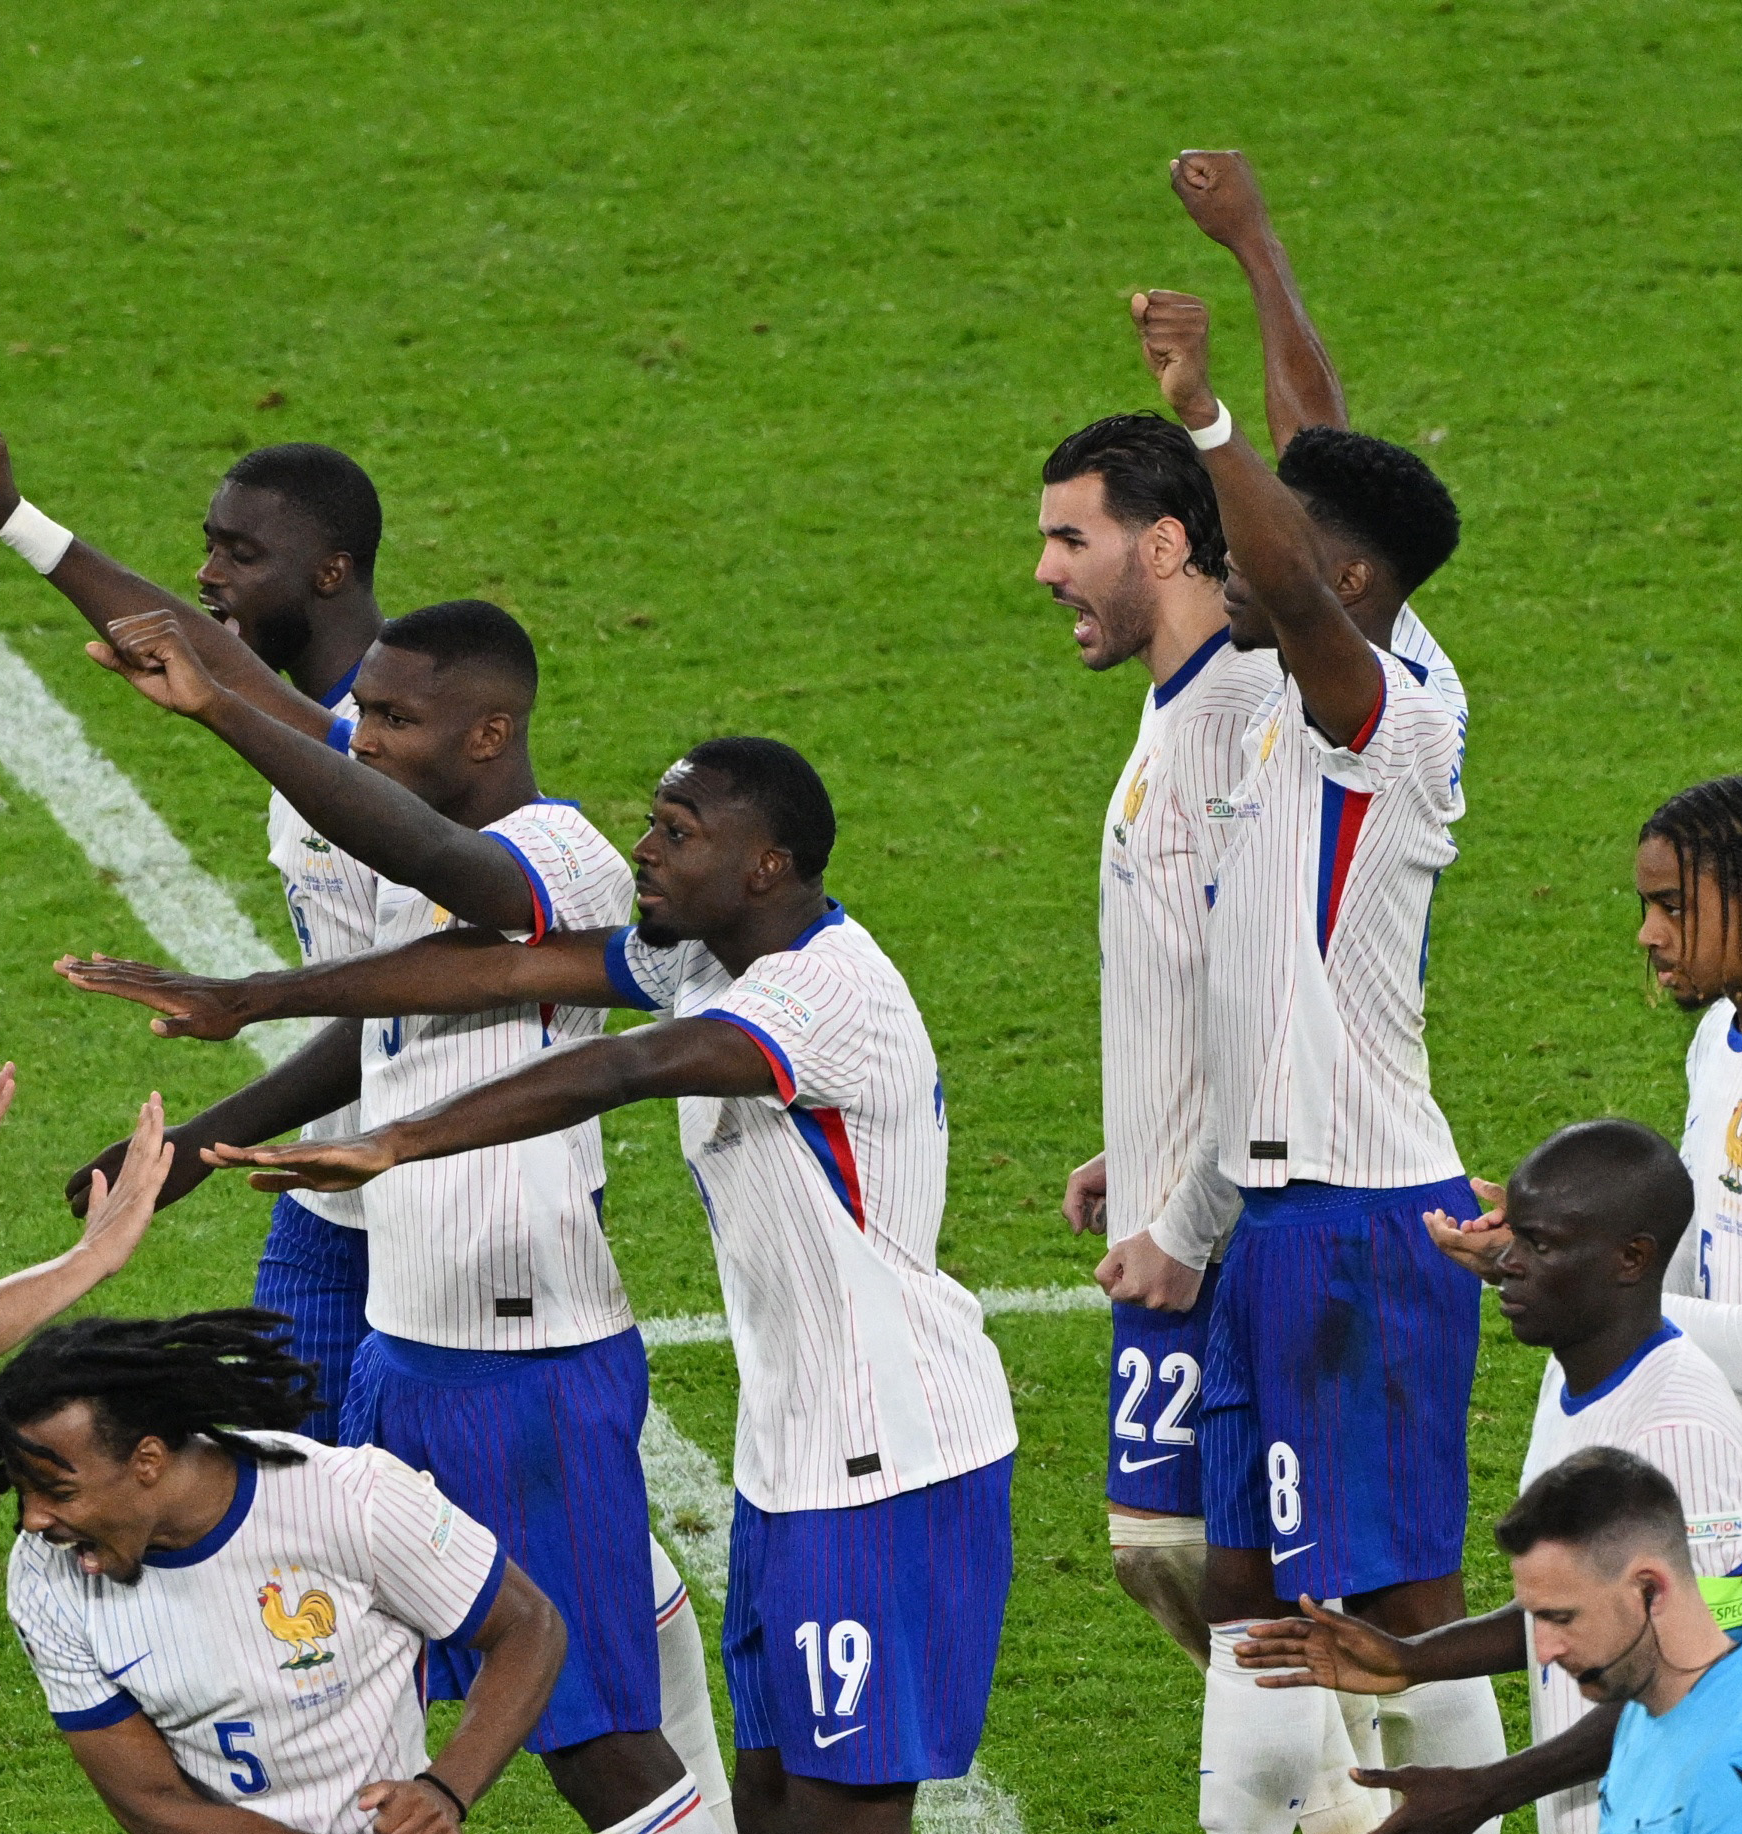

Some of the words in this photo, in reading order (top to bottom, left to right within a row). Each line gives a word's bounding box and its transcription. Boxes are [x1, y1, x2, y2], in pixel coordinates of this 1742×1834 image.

[1115, 1346, 1202, 1446] 22
[1267, 1440, 1303, 1536] 8
[794, 1619, 872, 1717] 19
[213, 1721, 272, 1796] 5
